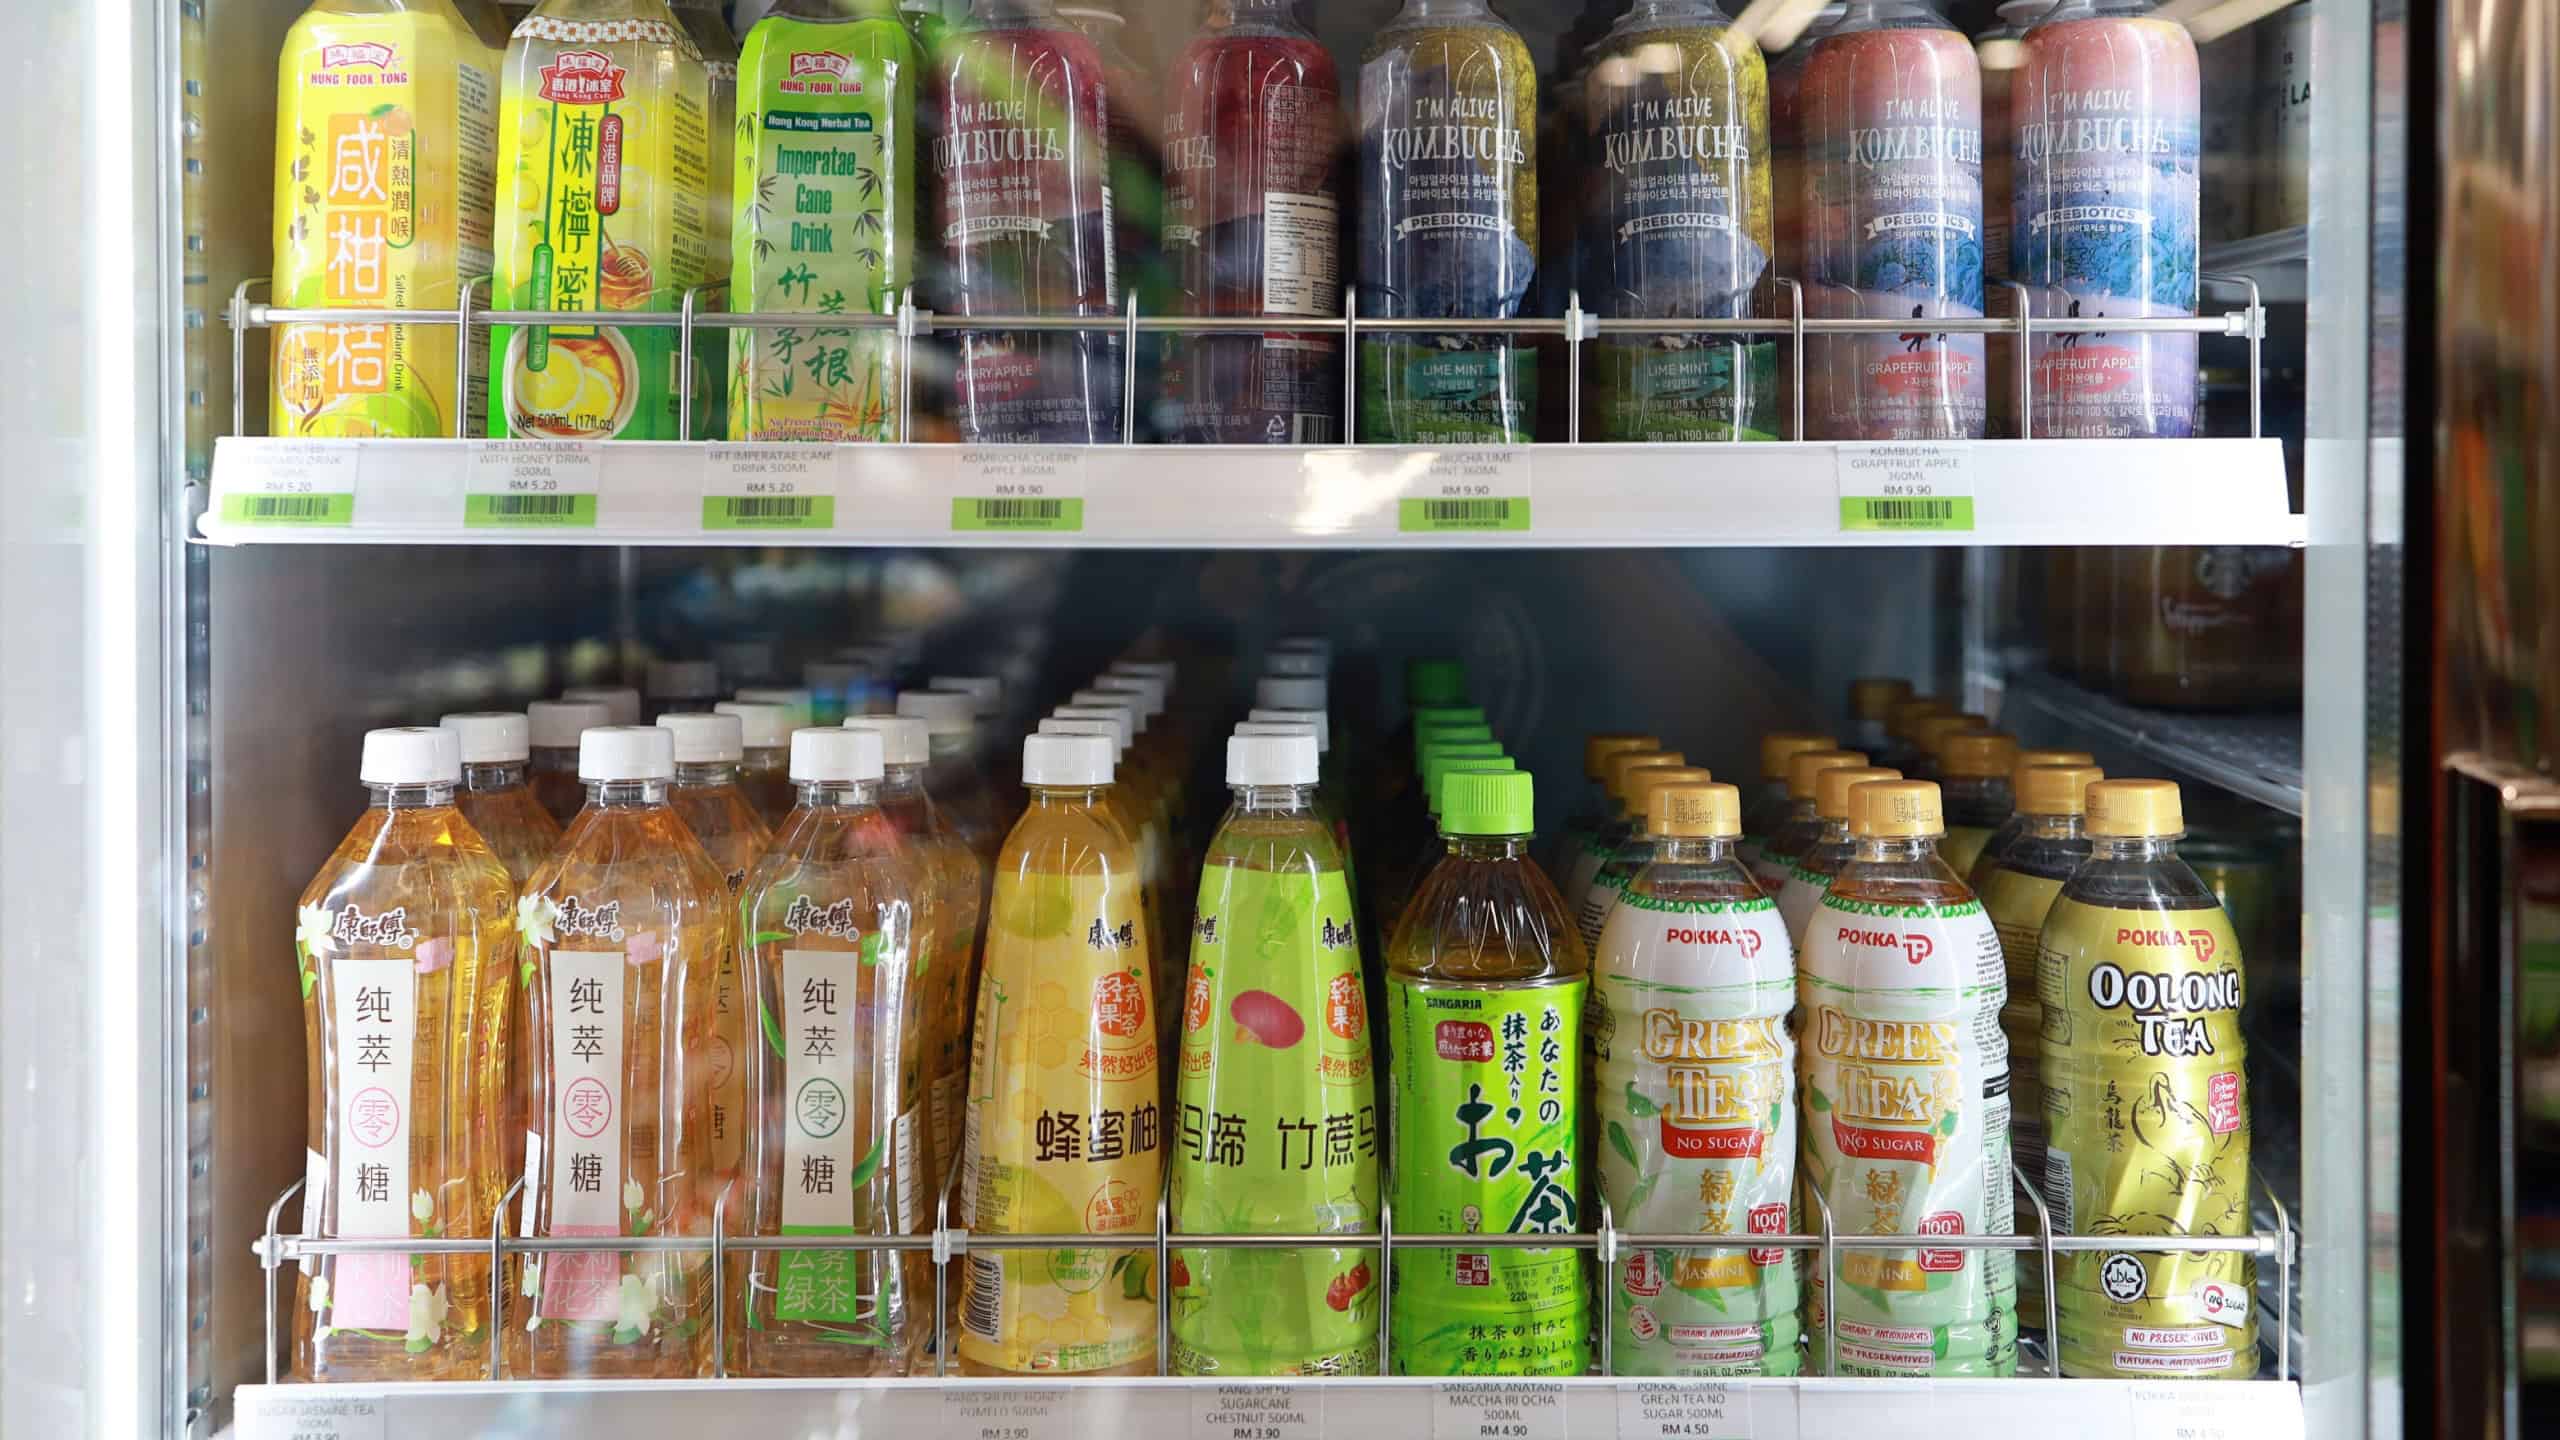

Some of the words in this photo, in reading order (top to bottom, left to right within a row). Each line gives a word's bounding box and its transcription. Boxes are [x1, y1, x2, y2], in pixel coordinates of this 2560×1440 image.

[311, 73, 339, 84] HUNG
[347, 74, 373, 84] FOOK
[381, 73, 407, 83] TONG
[780, 80, 804, 92] HUNG
[810, 81, 832, 93] FOOK
[839, 82, 861, 92] TONG
[1416, 98, 1444, 119] I'M
[1450, 94, 1496, 119] ALIVE
[2050, 91, 2076, 113] I'M
[2083, 89, 2132, 112] ALIVE
[978, 102, 1024, 121] ALIVE
[1633, 99, 1659, 122] I'M
[1665, 97, 1712, 118] ALIVE
[1886, 100, 1914, 120] I'M
[1919, 97, 1960, 120] ALVE
[768, 115, 792, 128] Hong
[795, 115, 818, 129] Kong
[821, 117, 851, 128] Herbal
[854, 118, 870, 128] Tea
[1381, 126, 1525, 169] KOMBUCHA
[1848, 125, 1982, 169] KOMBUCHA
[2020, 117, 2169, 166] KOMBUCHA
[933, 128, 1064, 175] KOMBUCHA
[1604, 125, 1749, 174] KOMBUCHA
[604, 120, 618, 210] 香港品牌
[776, 144, 856, 179] Imperatae
[391, 138, 409, 238] 清熱潤喉
[795, 184, 832, 214] Cane
[1411, 215, 1499, 228] PREBIOTICS
[1884, 214, 1964, 228] PREBIOICS
[2045, 207, 2136, 222] PREBIOTICS
[1633, 214, 1721, 230] PREBIOTICS
[791, 222, 832, 253] Drink
[328, 118, 386, 389] 咸柑桔
[394, 274, 406, 307] Salted
[1423, 365, 1451, 376] LIME
[1455, 364, 1486, 376] MINT
[1650, 363, 1677, 376] LIME
[1680, 362, 1710, 375] MINT
[1867, 362, 1941, 375] GRAPEFRUIT
[2032, 358, 2097, 370] GRAPEFRUIT
[2102, 357, 2143, 369] APPLE
[394, 363, 405, 391] Drink
[996, 365, 1033, 377] APPLE
[1680, 430, 1702, 441] (100
[1705, 428, 1728, 441] kcal)
[2081, 424, 2104, 438] (115
[2107, 423, 2130, 437] kcal)
[1870, 446, 1940, 456] KOMBUCHA
[480, 455, 508, 464] WITH
[512, 454, 551, 464] HONEY
[556, 454, 591, 464] DRINK
[1851, 459, 1920, 468] GRAPEFRUIT
[1924, 459, 1960, 468] APPLE
[514, 467, 551, 477] 500ML
[732, 463, 766, 473] DRINK
[770, 463, 808, 473] 500ML
[509, 480, 528, 490] RM
[531, 480, 557, 490] 5.20
[746, 482, 765, 492] RM
[768, 482, 794, 492] 5.20
[996, 484, 1015, 494] RM
[1018, 484, 1043, 494] 9.90
[1442, 485, 1460, 495] RM
[1463, 485, 1489, 495] 9.90
[1884, 485, 1903, 495] RM
[1906, 485, 1931, 495] 9.90
[1666, 928, 1732, 944] POKKA
[1838, 928, 1899, 948] POKKA
[2117, 928, 2187, 946] POKKA
[2089, 962, 2240, 1014] OOLONG
[1426, 998, 1482, 1010] SANGARIA
[1819, 1005, 1961, 1066] GREEN
[2132, 1012, 2215, 1057] TEA
[1540, 1008, 1560, 1122] あなたの
[569, 977, 605, 1193] 纯萃零糖
[801, 977, 838, 1195] 纯萃零糖
[355, 986, 393, 1203] 纯萃零糖
[1840, 1066, 1932, 1123] TEA
[2102, 1080, 2124, 1152] 烏龍茶
[1036, 1101, 1157, 1162] 蜂蜜柚
[1182, 1104, 1247, 1168] 马蹄
[1677, 1139, 1702, 1149] NO
[1708, 1137, 1757, 1149] SUGAR
[1841, 1132, 1866, 1147] NO
[1872, 1136, 1925, 1151] SUGAR
[783, 1275, 849, 1314] 绿茶
[2132, 1333, 2145, 1342] NO
[2150, 1332, 2218, 1343] PRESERTIVES
[2119, 1355, 2164, 1366] NATURAL
[1523, 1366, 1556, 1377] Green
[1442, 1384, 1502, 1393] SANGARIA
[1505, 1384, 1562, 1393] ANATANO
[1638, 1384, 1677, 1392] POKKA
[1221, 1399, 1290, 1410] SUGARCANE
[1450, 1396, 1502, 1407] MACCHA
[1522, 1396, 1556, 1407] OCHA
[1683, 1394, 1706, 1405] TEA
[1708, 1394, 1727, 1405] NO
[353, 1404, 376, 1415] TEA
[1484, 1410, 1521, 1420] 500ML
[1643, 1409, 1683, 1420] SUGAR
[1687, 1409, 1724, 1420] 500ML
[1207, 1412, 1264, 1424] CHESTNUT
[1269, 1412, 1305, 1424] 500ML
[982, 1427, 1000, 1439] RM
[1003, 1427, 1029, 1439] 3.90
[1234, 1428, 1252, 1439] RM
[1255, 1427, 1280, 1439] 3.90
[1480, 1425, 1500, 1436] RM
[1503, 1425, 1528, 1436] 4.90
[1662, 1424, 1681, 1435] RM
[1684, 1424, 1710, 1435] 4.50
